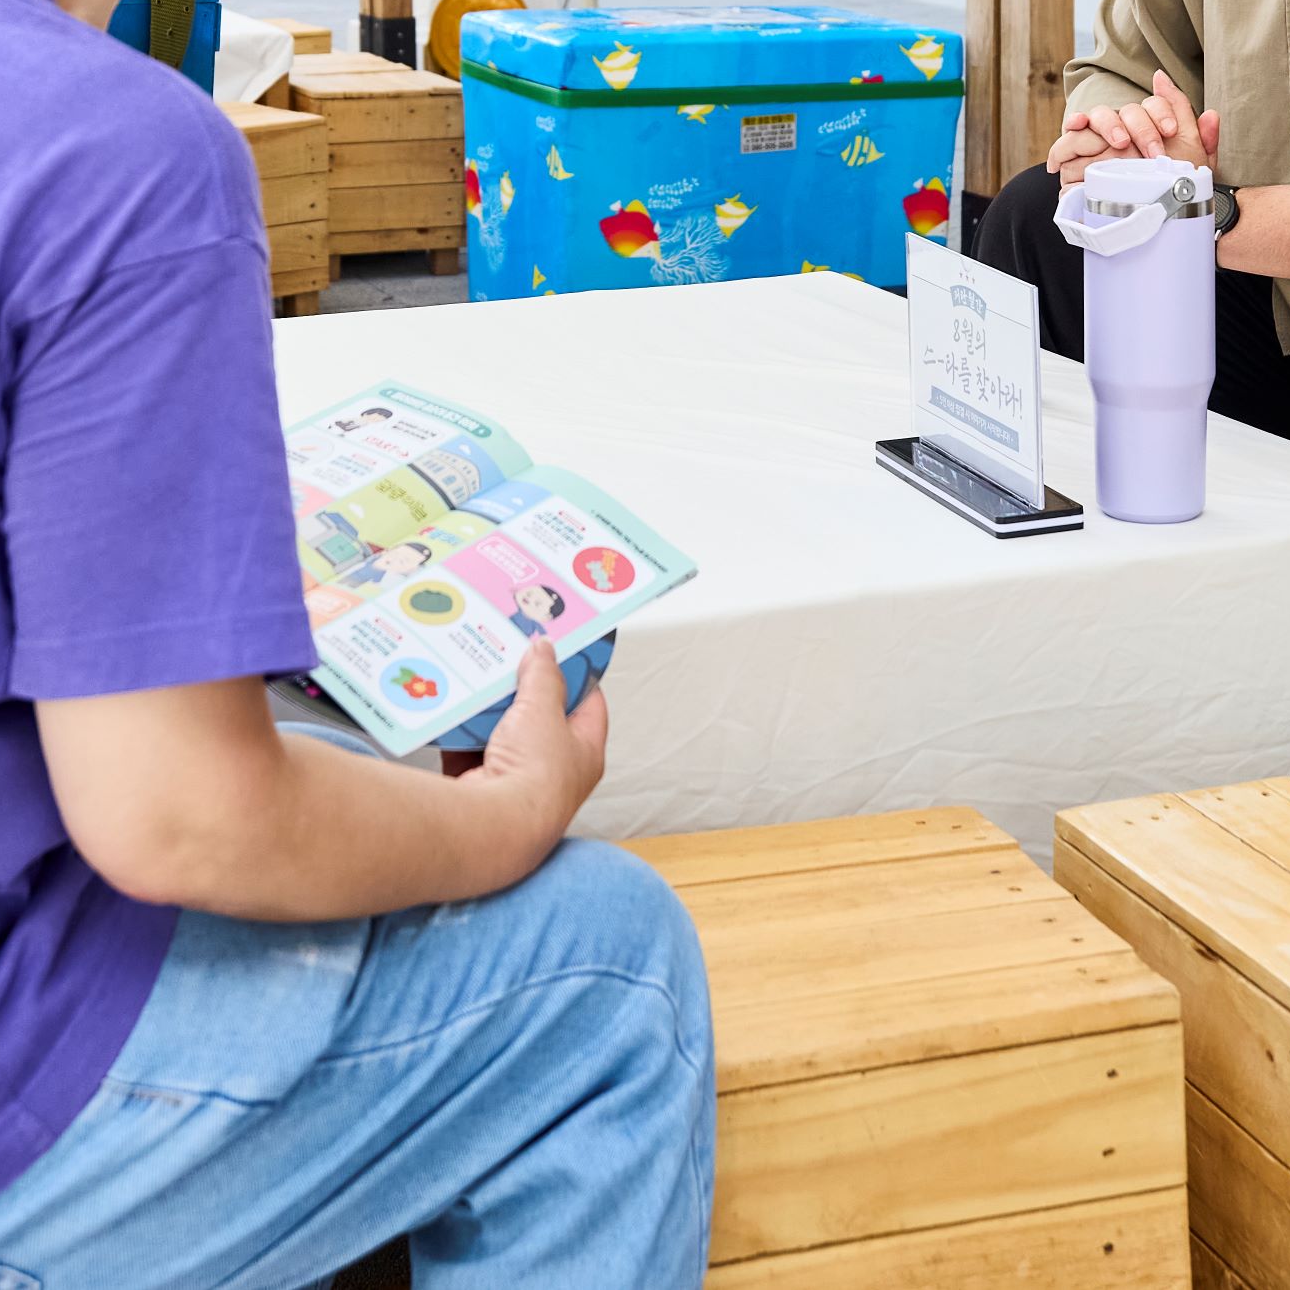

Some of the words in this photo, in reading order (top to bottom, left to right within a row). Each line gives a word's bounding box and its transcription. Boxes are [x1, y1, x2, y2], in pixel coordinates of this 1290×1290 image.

[953, 318, 986, 360] 8월의
[923, 344, 972, 394] 스-타를
[976, 365, 1023, 420] 찾아라!
